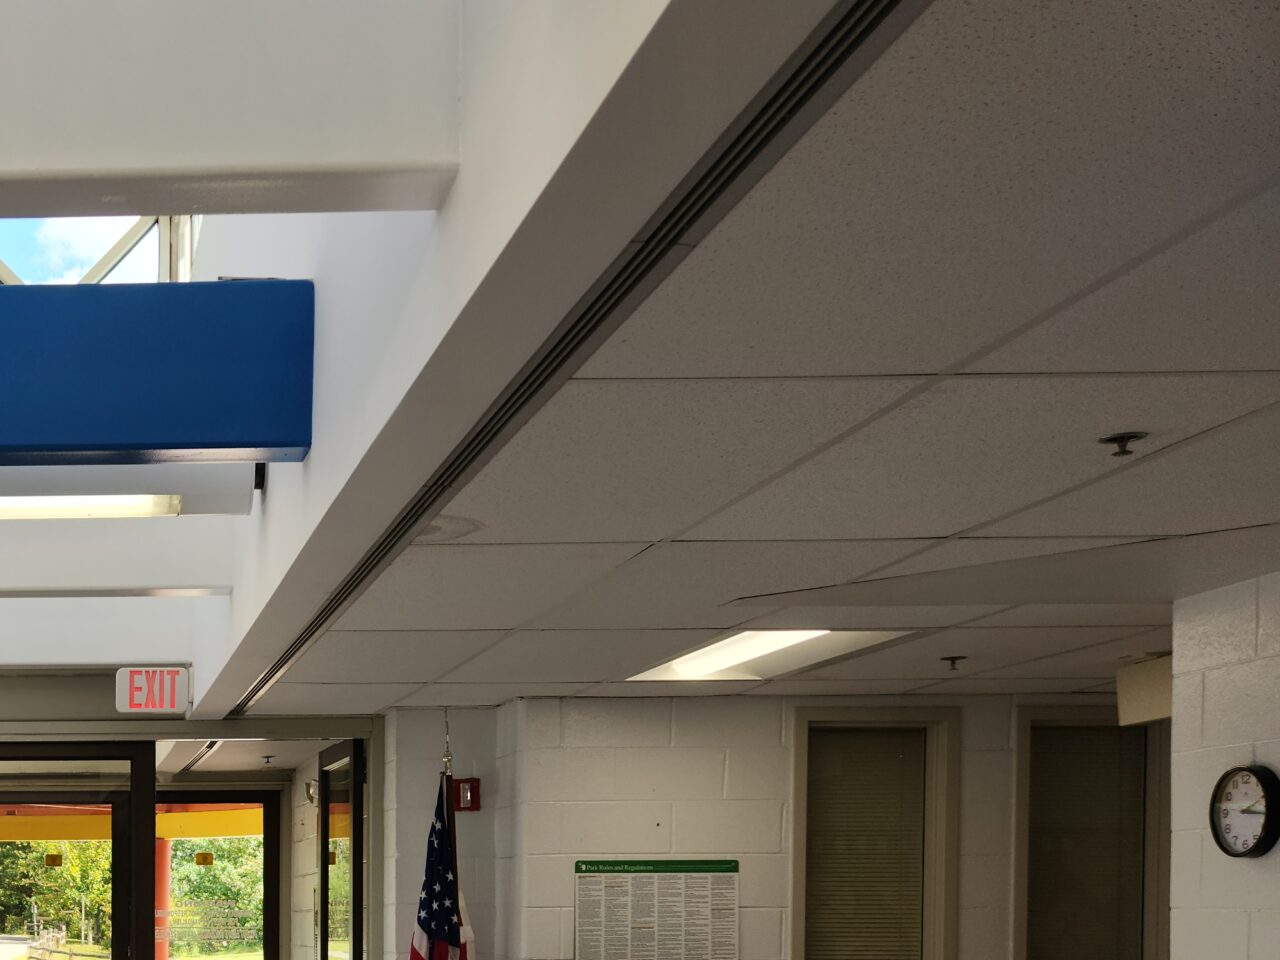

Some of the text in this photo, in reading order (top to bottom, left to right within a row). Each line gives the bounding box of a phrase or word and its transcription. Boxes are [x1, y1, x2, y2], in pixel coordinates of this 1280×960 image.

[129, 670, 180, 709] EXIT
[1241, 775, 1251, 784] 12
[1233, 780, 1238, 790] 11
[1225, 792, 1232, 801] 10
[1222, 809, 1228, 819] 9
[1224, 824, 1231, 834] 8
[1232, 836, 1238, 845] 7
[1242, 840, 1248, 849] 6
